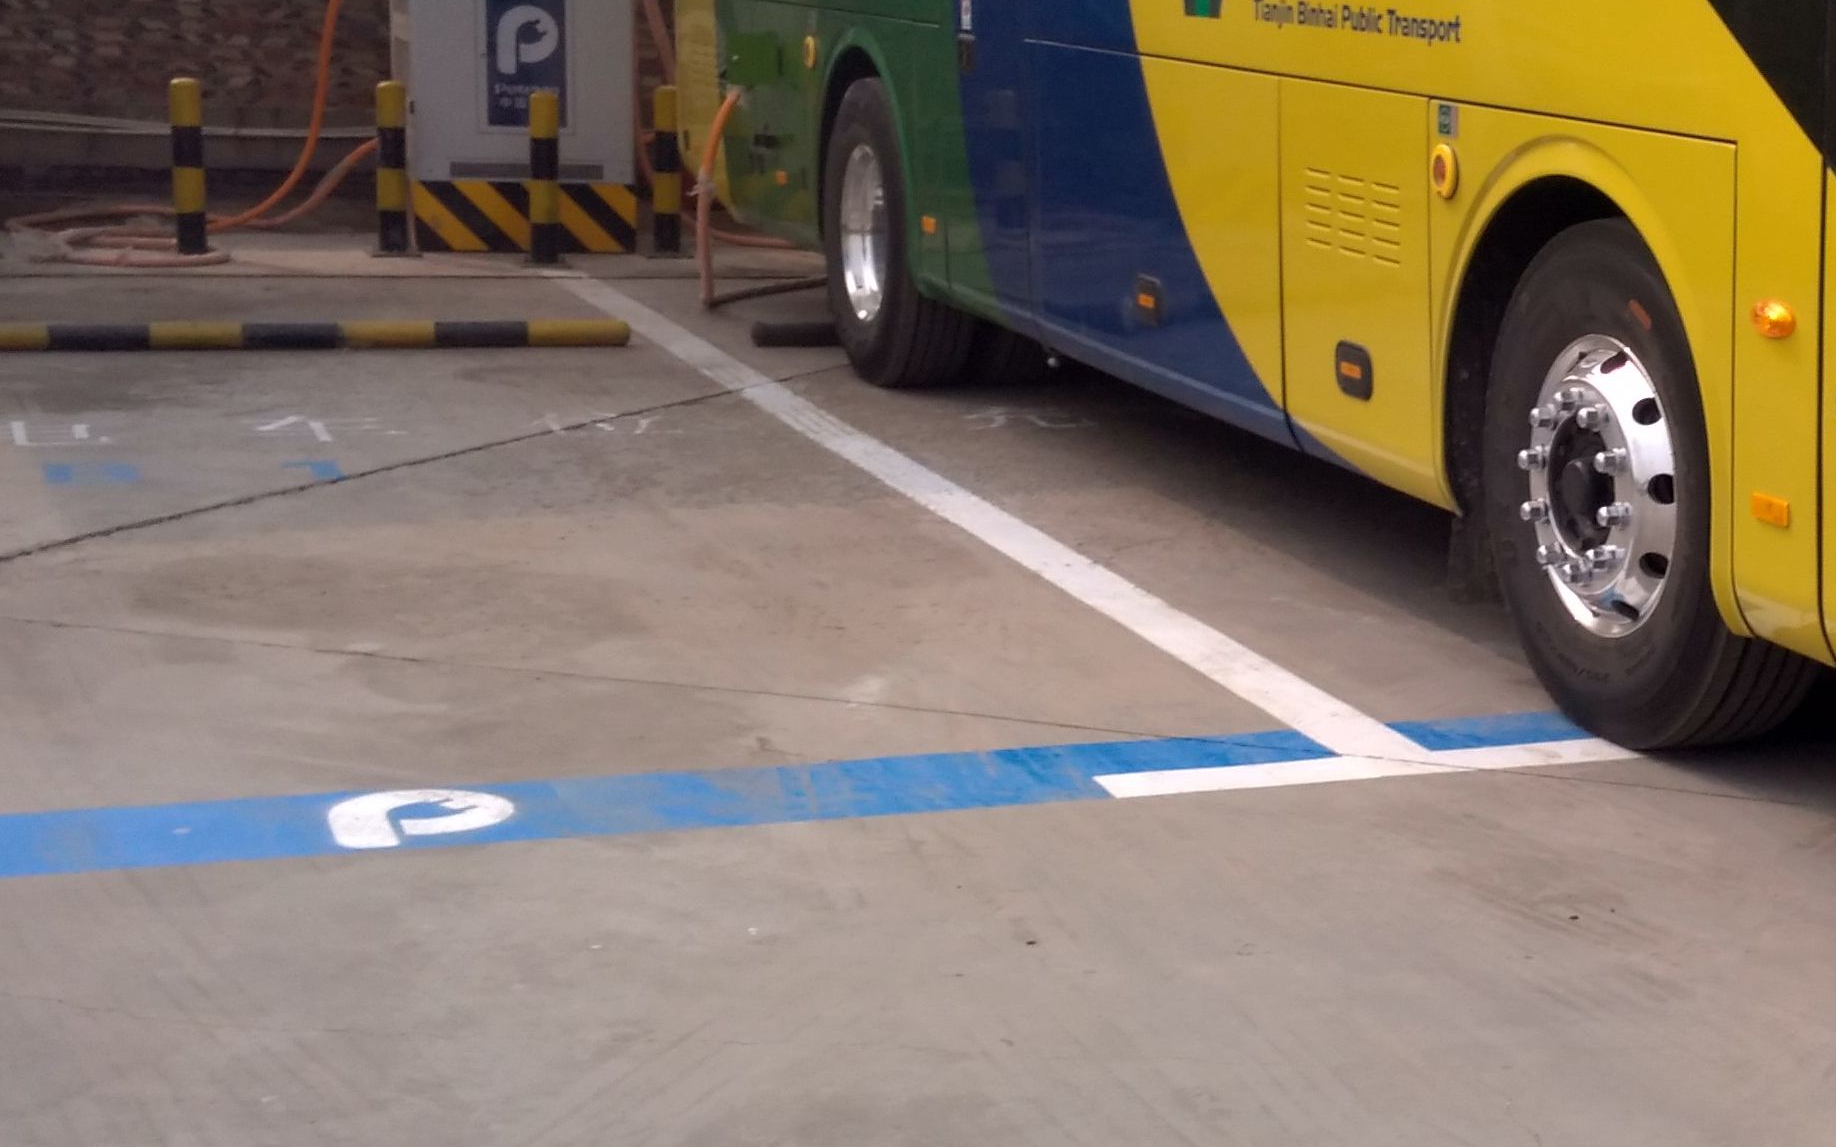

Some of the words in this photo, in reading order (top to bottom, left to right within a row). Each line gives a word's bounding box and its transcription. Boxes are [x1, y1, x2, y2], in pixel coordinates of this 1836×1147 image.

[1296, 0, 1338, 29] Binhai
[1340, 4, 1384, 34] Public
[1386, 8, 1461, 47] Transport
